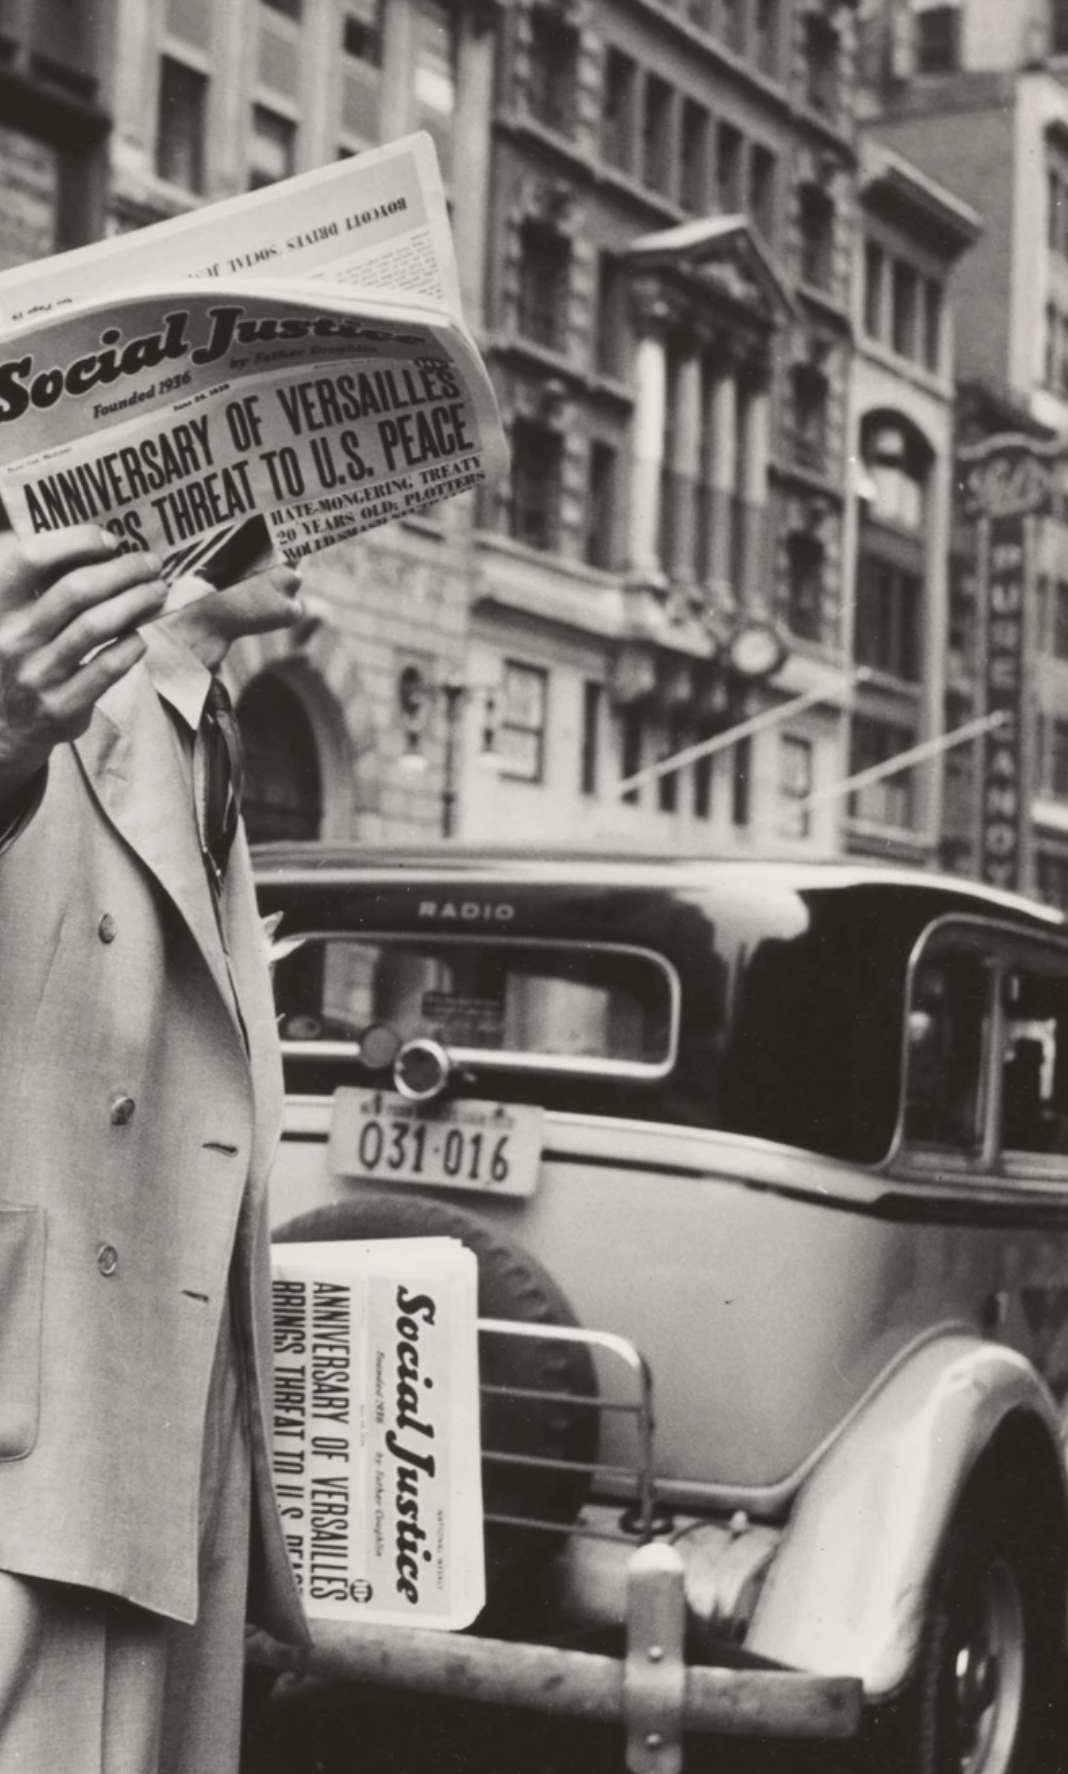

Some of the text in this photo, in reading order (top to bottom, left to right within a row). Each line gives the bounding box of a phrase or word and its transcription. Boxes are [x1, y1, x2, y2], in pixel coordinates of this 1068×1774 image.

[285, 218, 339, 252] DRIVES
[344, 196, 408, 235] BOYCOTT
[191, 307, 427, 366] Justice
[92, 387, 153, 420] Founded
[158, 370, 192, 397] 1936
[22, 413, 215, 535] ANNIVERSARY
[225, 393, 263, 453] OF
[274, 367, 461, 436] VERSAILLES
[150, 460, 256, 546] THREAT
[260, 445, 305, 501] TO
[311, 429, 374, 488] U.S.
[377, 401, 475, 471] PEACE
[418, 454, 483, 484] TREATY
[276, 528, 297, 546] 20
[301, 510, 356, 536] YEARS
[403, 470, 487, 507] PLOTTERS
[418, 901, 516, 921] RADIO
[272, 1280, 306, 1355] BRINGS
[273, 1365, 306, 1441] THREAT
[273, 1450, 305, 1475] TO
[310, 1281, 351, 1602] ANNIVERSARY OF VERSAILLES
[385, 1284, 436, 1605] Social Justice
